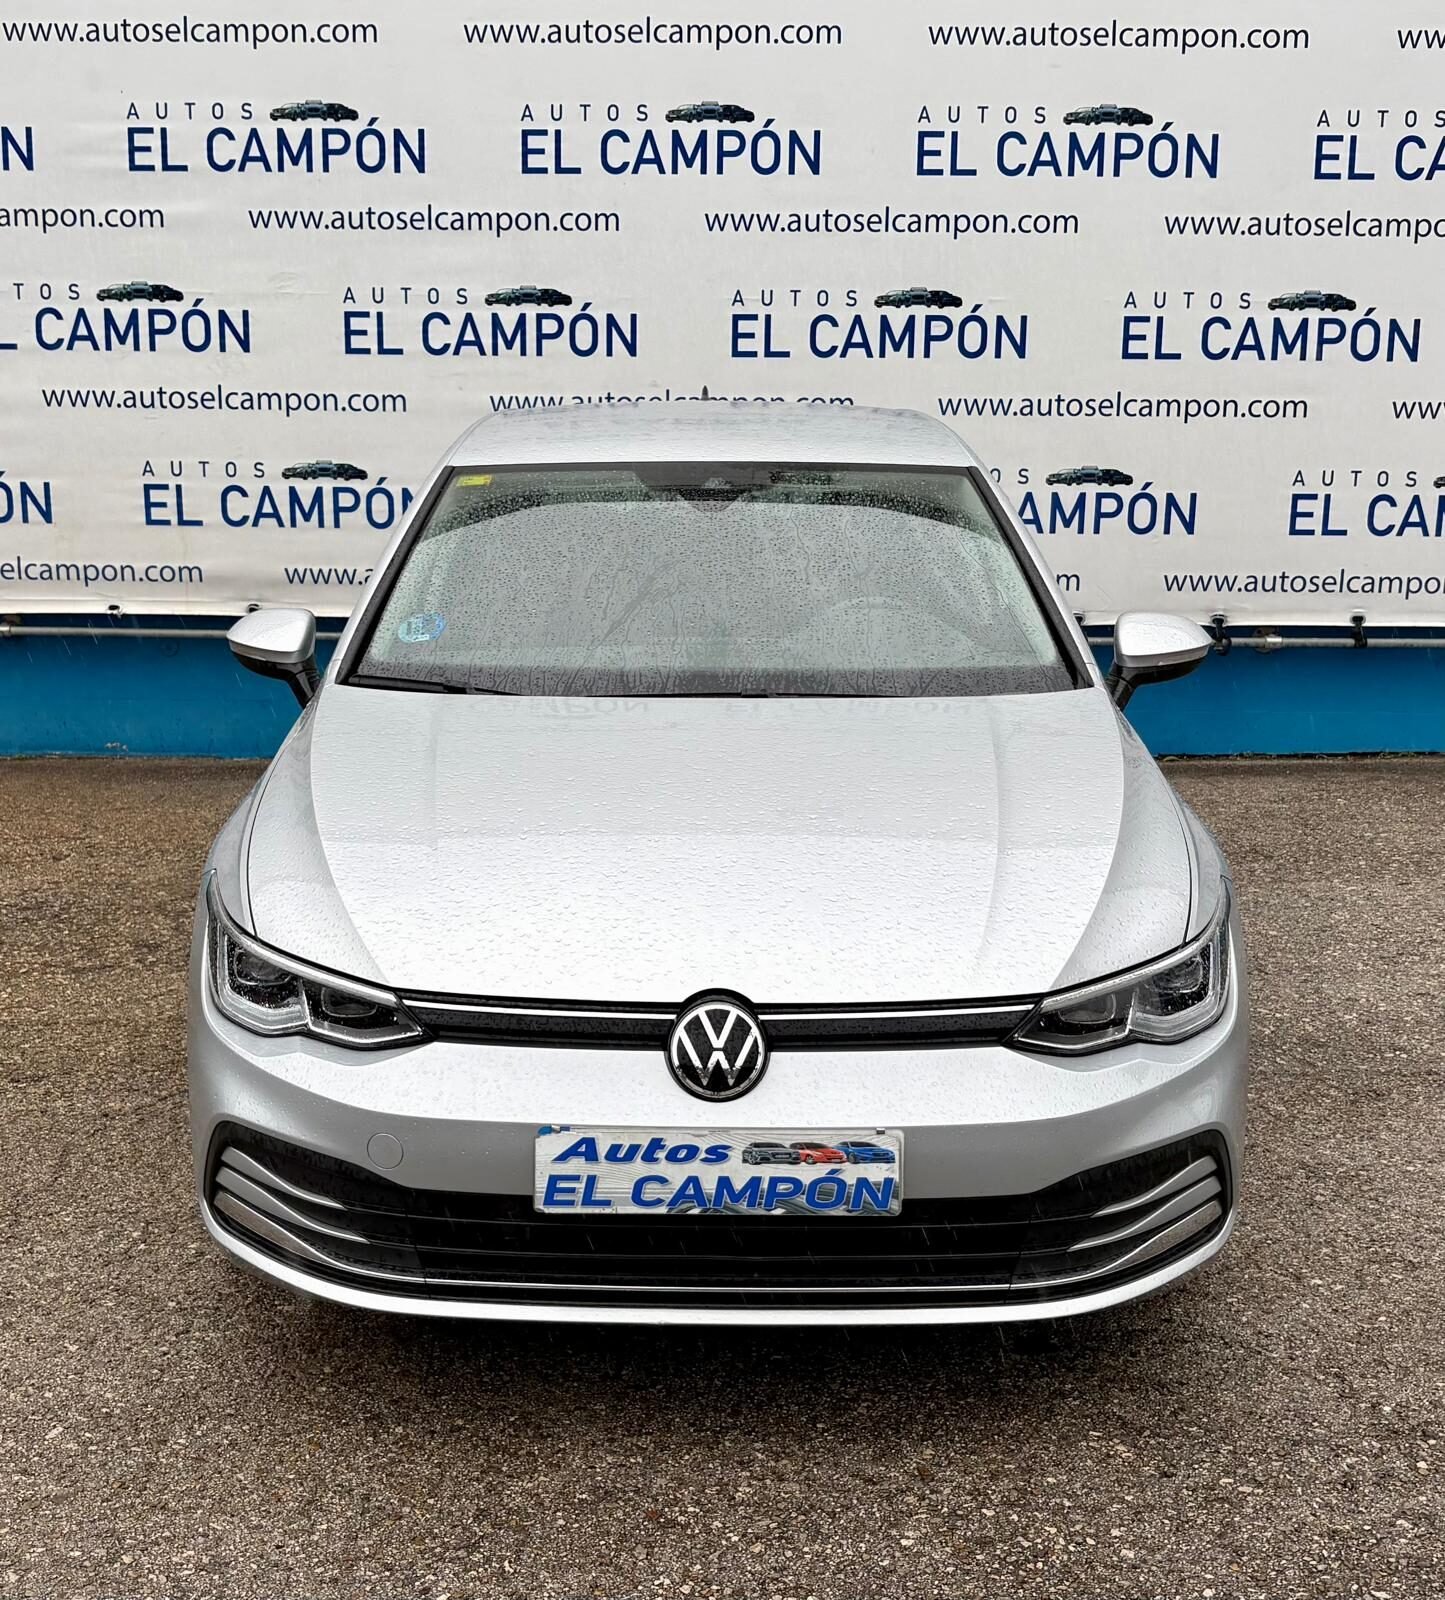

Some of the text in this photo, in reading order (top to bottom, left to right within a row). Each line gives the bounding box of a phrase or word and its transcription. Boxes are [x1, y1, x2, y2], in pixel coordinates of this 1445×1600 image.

[2, 15, 378, 50] www.autoselcampon.com
[463, 15, 842, 51] www.autoselcampon.com
[928, 19, 1309, 55] www.autoselcampon.com
[126, 102, 253, 121] AUTOS
[520, 103, 649, 122] AUTOS
[917, 105, 1046, 125] AUTOS
[127, 116, 426, 174] EL CAMPÓN
[521, 118, 821, 176] EL CAMPÓN
[916, 121, 1220, 179] EL CAMPÓN
[1313, 134, 1376, 181] EL
[247, 203, 620, 239] www.autoselcampon.com
[704, 205, 1079, 240] www.autoselcampon.com
[342, 286, 468, 305] AUTOS
[731, 289, 858, 308] AUTOS
[1123, 291, 1251, 310] AUTOS
[35, 298, 251, 354] CAMPÓN
[343, 302, 638, 358] EL CAMPÓN
[731, 304, 1028, 360] EL CAMPÓN
[1121, 307, 1421, 363] EL CAMPÓN
[41, 383, 407, 418] www.autoselcampon.com
[937, 390, 1308, 425] www.autoselcampon.com
[1392, 401, 1445, 420] ww
[141, 460, 265, 479] AUTOS
[1291, 469, 1417, 488] AUTOS
[142, 483, 204, 527] EL
[1288, 493, 1445, 538] EL CA
[1163, 568, 1445, 601] www.autoselcampo
[551, 1136, 732, 1164] Autos
[542, 1168, 895, 1211] EL CAMPÓN
